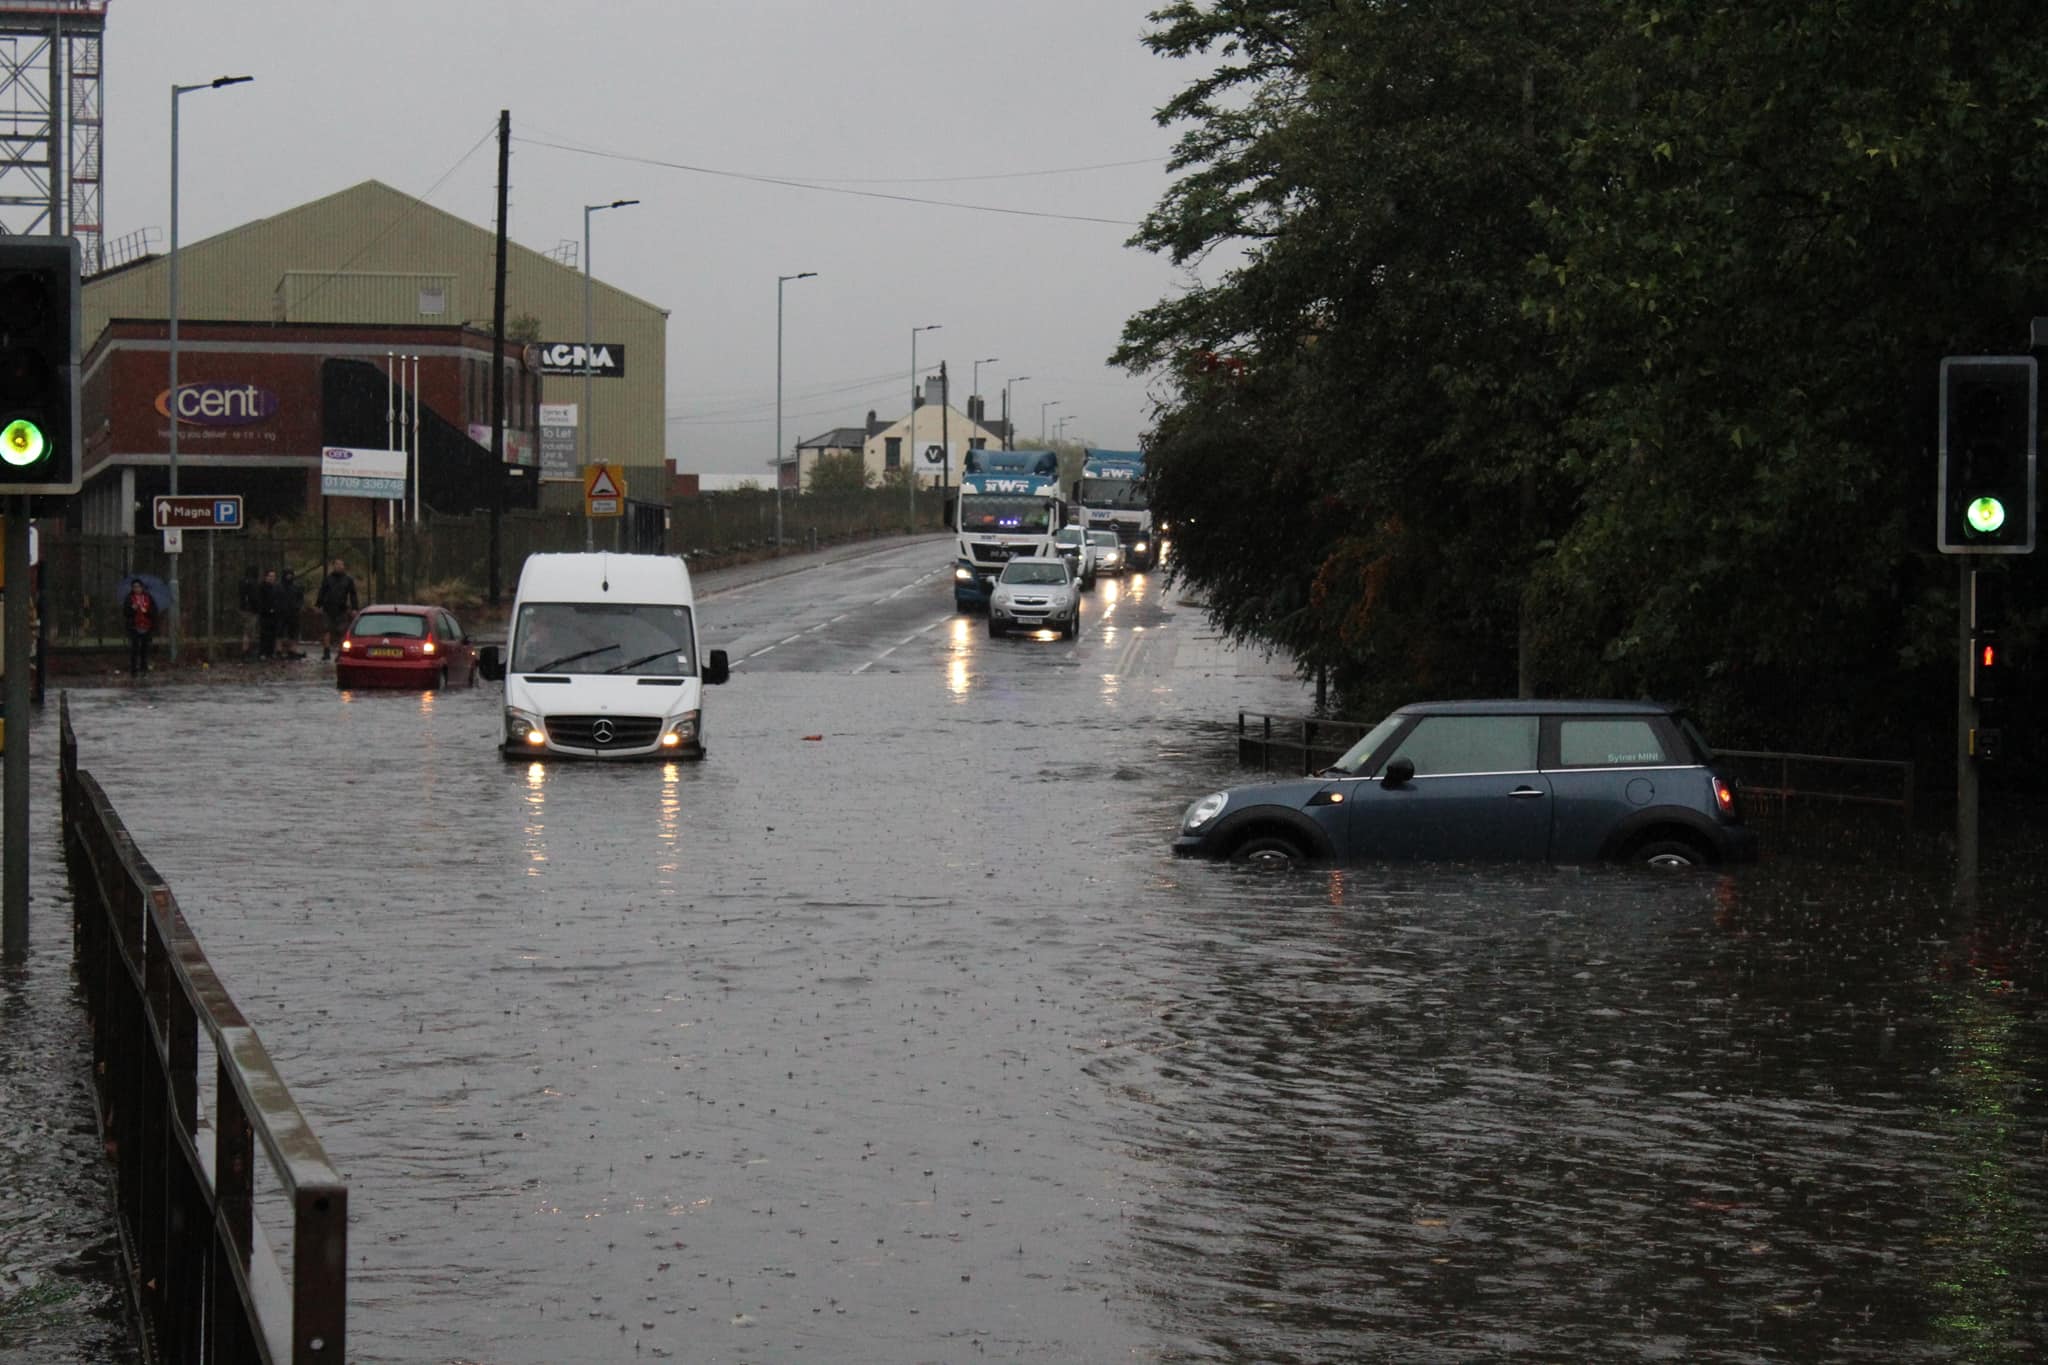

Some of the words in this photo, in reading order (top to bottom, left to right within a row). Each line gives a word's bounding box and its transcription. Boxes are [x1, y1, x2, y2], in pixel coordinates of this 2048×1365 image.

[177, 385, 259, 417] cent
[543, 428, 554, 438] To
[556, 428, 572, 438] Let
[929, 449, 938, 460] V
[1102, 468, 1134, 479] NWT
[985, 480, 1029, 492] NWT
[174, 506, 211, 518] Magna
[220, 504, 234, 521] P
[1638, 752, 1659, 761] MINI
